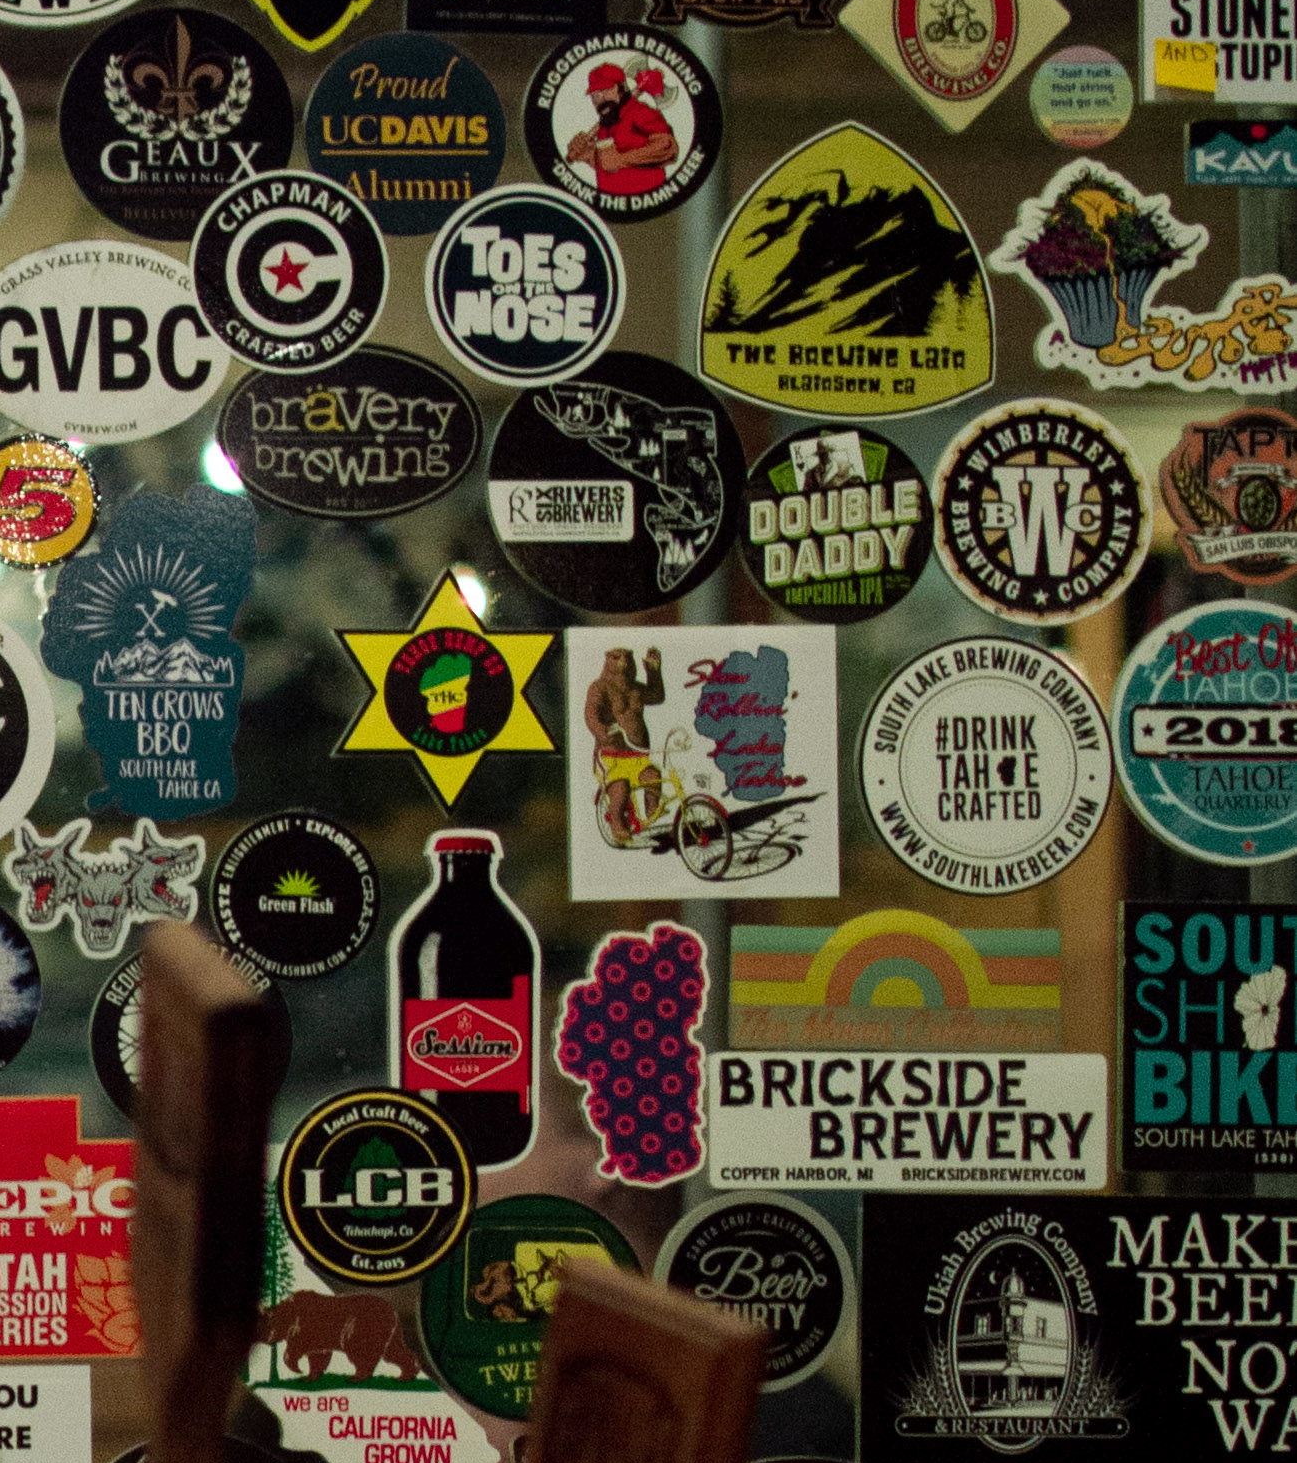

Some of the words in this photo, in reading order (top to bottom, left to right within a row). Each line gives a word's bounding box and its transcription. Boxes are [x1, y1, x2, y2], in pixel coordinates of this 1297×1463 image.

[351, 56, 459, 101] Proud
[347, 173, 473, 202] Alumni
[460, 226, 586, 292] TOES
[453, 295, 597, 343] NOSE
[255, 436, 451, 489] brewing
[749, 479, 922, 545] DOUBLE
[763, 529, 909, 587] DADDY
[106, 690, 145, 722] TEN
[151, 691, 225, 723] CROWS
[138, 723, 191, 757] BBQ
[936, 716, 1037, 751] #DRINK
[936, 791, 1042, 822] CRAFTED
[412, 1027, 514, 1059] Session
[717, 1058, 1028, 1107] BRICKSIDE
[809, 1110, 1094, 1162] BREWERY
[301, 1167, 453, 1208] LCB
[721, 1167, 780, 1181] COPPER
[785, 1167, 852, 1182] HARBOR,
[329, 1415, 458, 1441] CALIFORNIA
